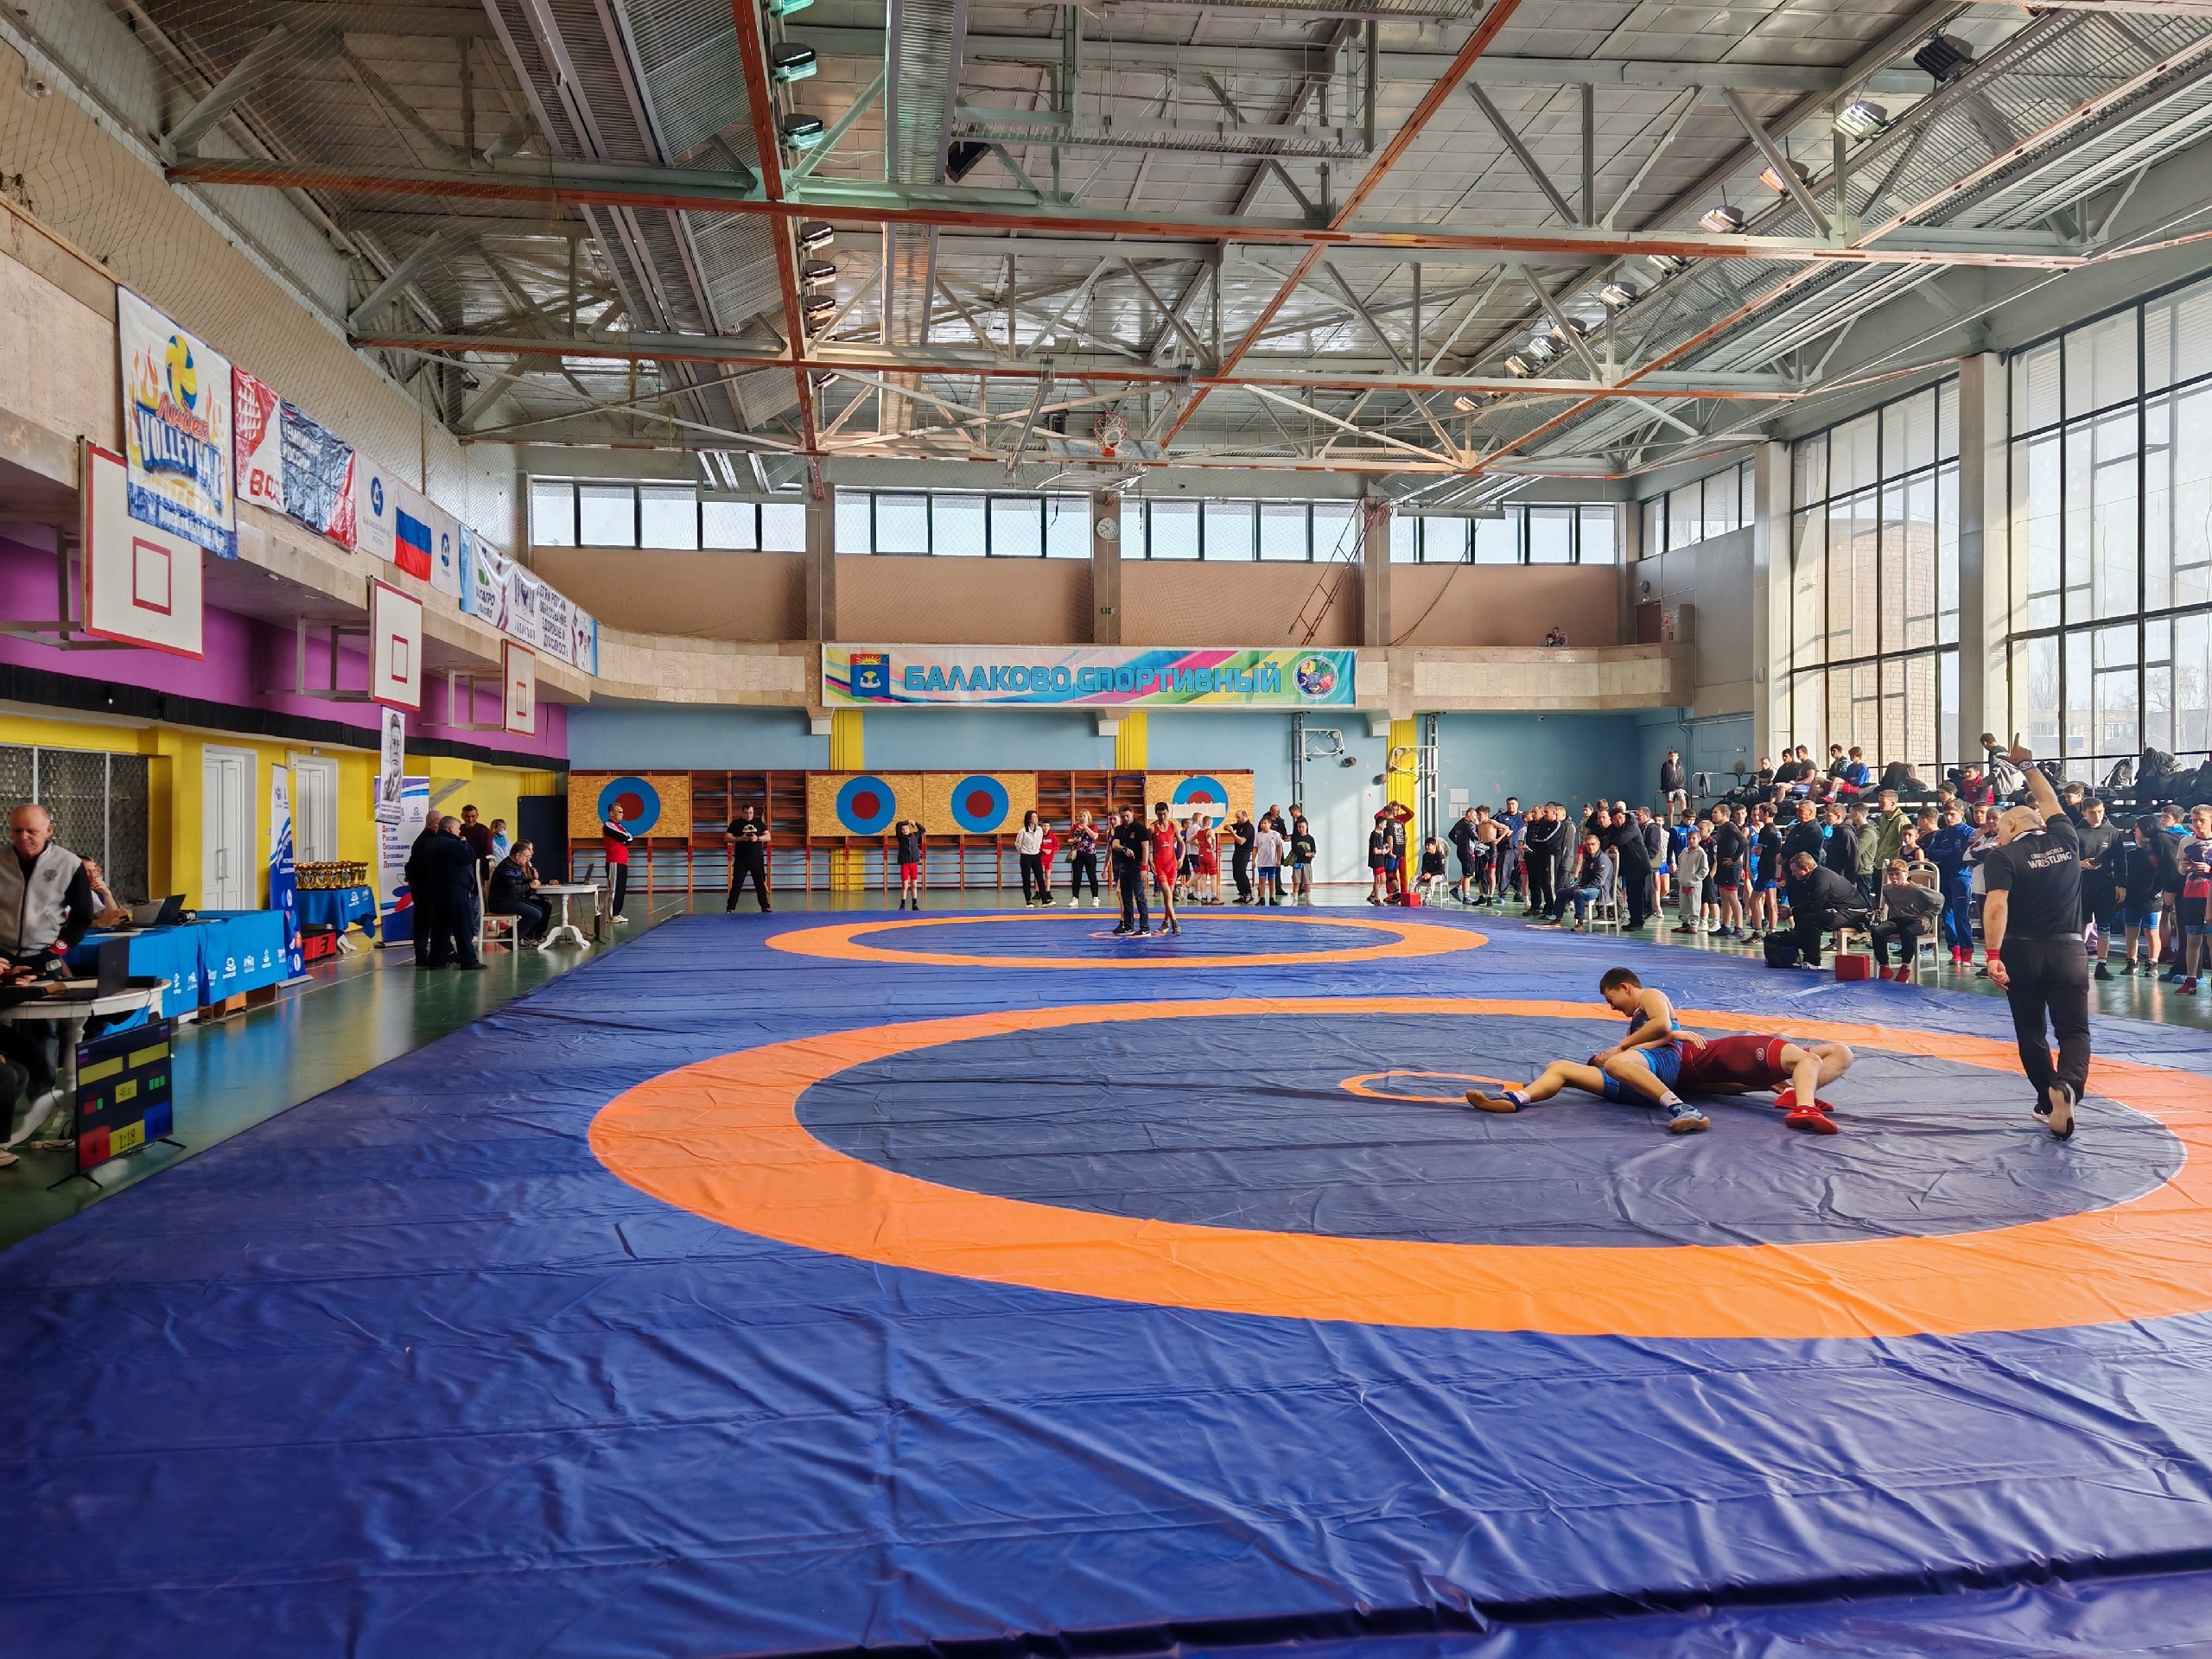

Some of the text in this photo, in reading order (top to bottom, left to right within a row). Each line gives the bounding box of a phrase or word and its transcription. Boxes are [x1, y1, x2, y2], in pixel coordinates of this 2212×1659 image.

[905, 665, 1072, 692] БАЛАКОВО
[1077, 661, 1282, 693] СПОРТИВНЫЙ
[2027, 851, 2072, 868] WRESTLING
[320, 937, 330, 954] 3
